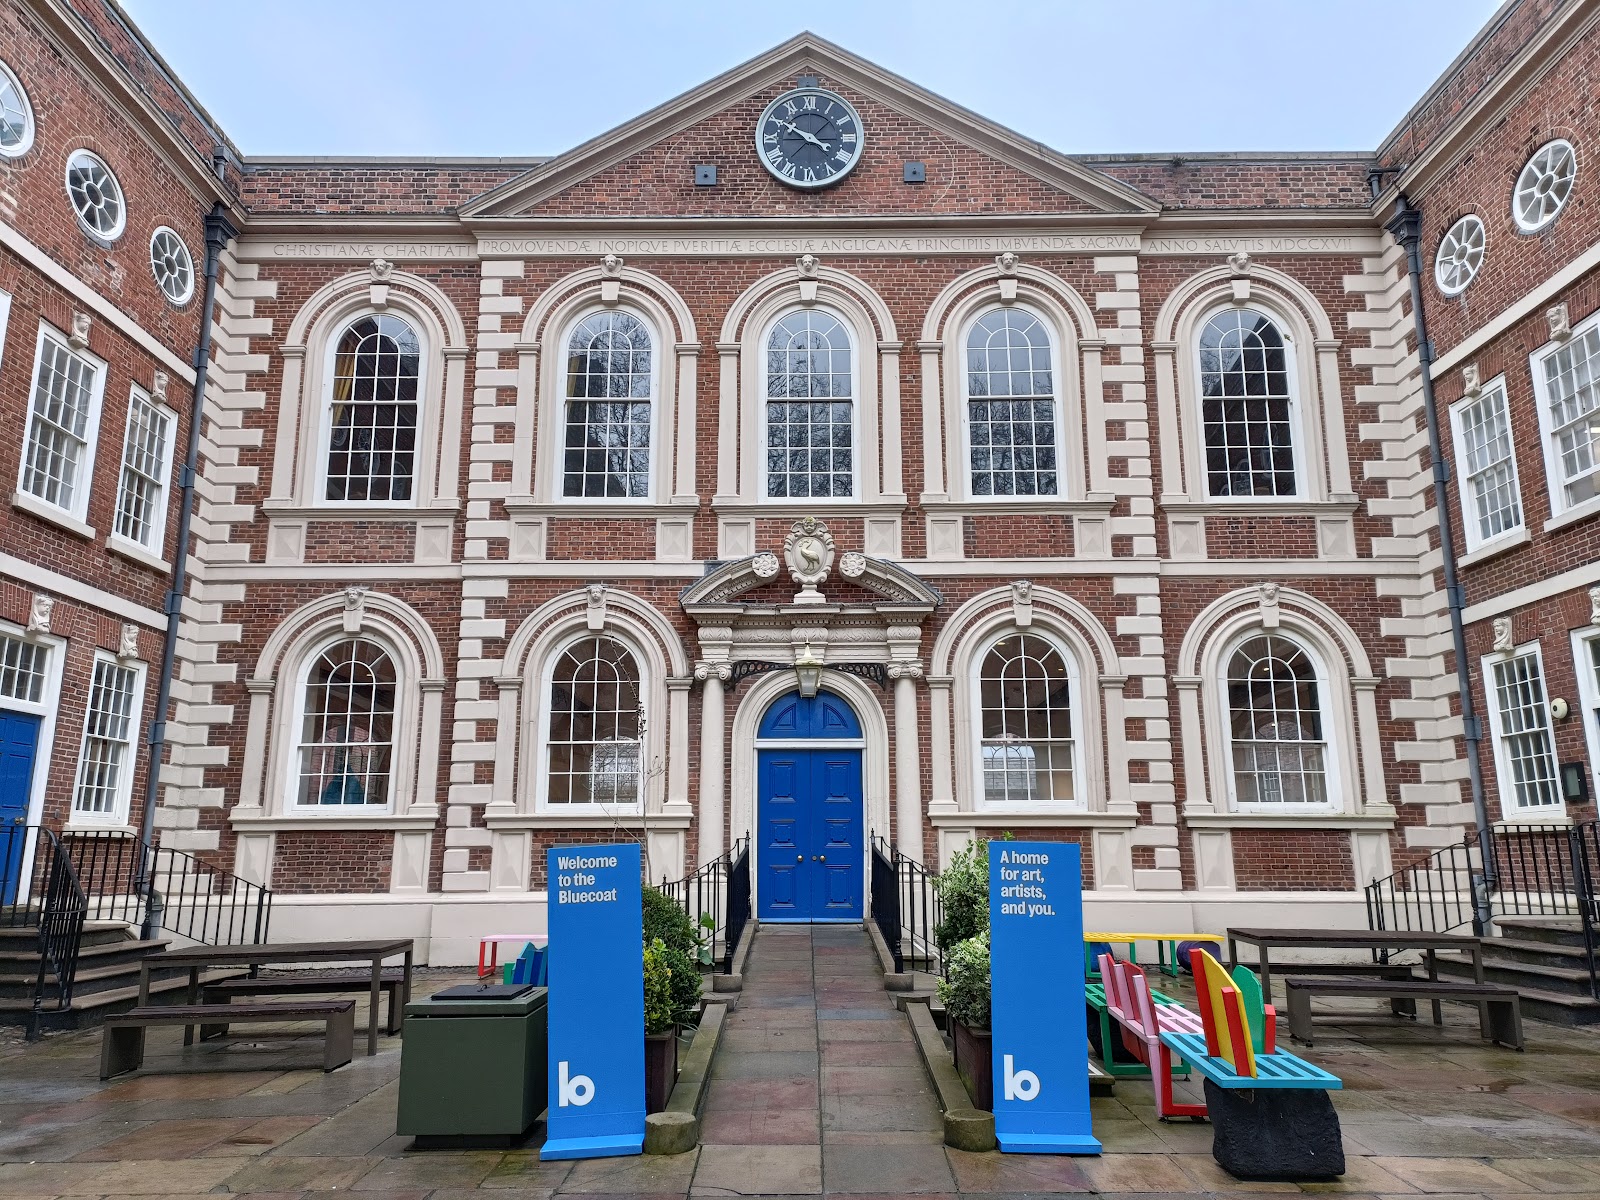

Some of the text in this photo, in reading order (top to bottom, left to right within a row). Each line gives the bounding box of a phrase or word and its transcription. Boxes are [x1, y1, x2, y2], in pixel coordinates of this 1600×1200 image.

[783, 100, 798, 115] XI
[803, 96, 817, 110] XII
[824, 101, 834, 114] I
[768, 114, 783, 127] X
[836, 114, 851, 125] II
[764, 132, 778, 144] IX
[842, 133, 856, 143] III
[766, 147, 784, 167] VIII
[781, 162, 796, 179] VII
[804, 168, 817, 181] VI
[824, 162, 836, 177] V
[383, 244, 471, 257] CHARITATI
[1081, 237, 1137, 249] SACRVM
[1149, 240, 1198, 252] ANNO
[1205, 239, 1264, 252] SALVTIS
[557, 855, 617, 870] Welcome
[1000, 850, 1049, 865] A home
[557, 872, 595, 887] to the
[1000, 866, 1045, 884] for art,
[558, 887, 617, 904] Bluecoat
[1000, 883, 1047, 901] artists,
[1001, 901, 1056, 918] and you.
